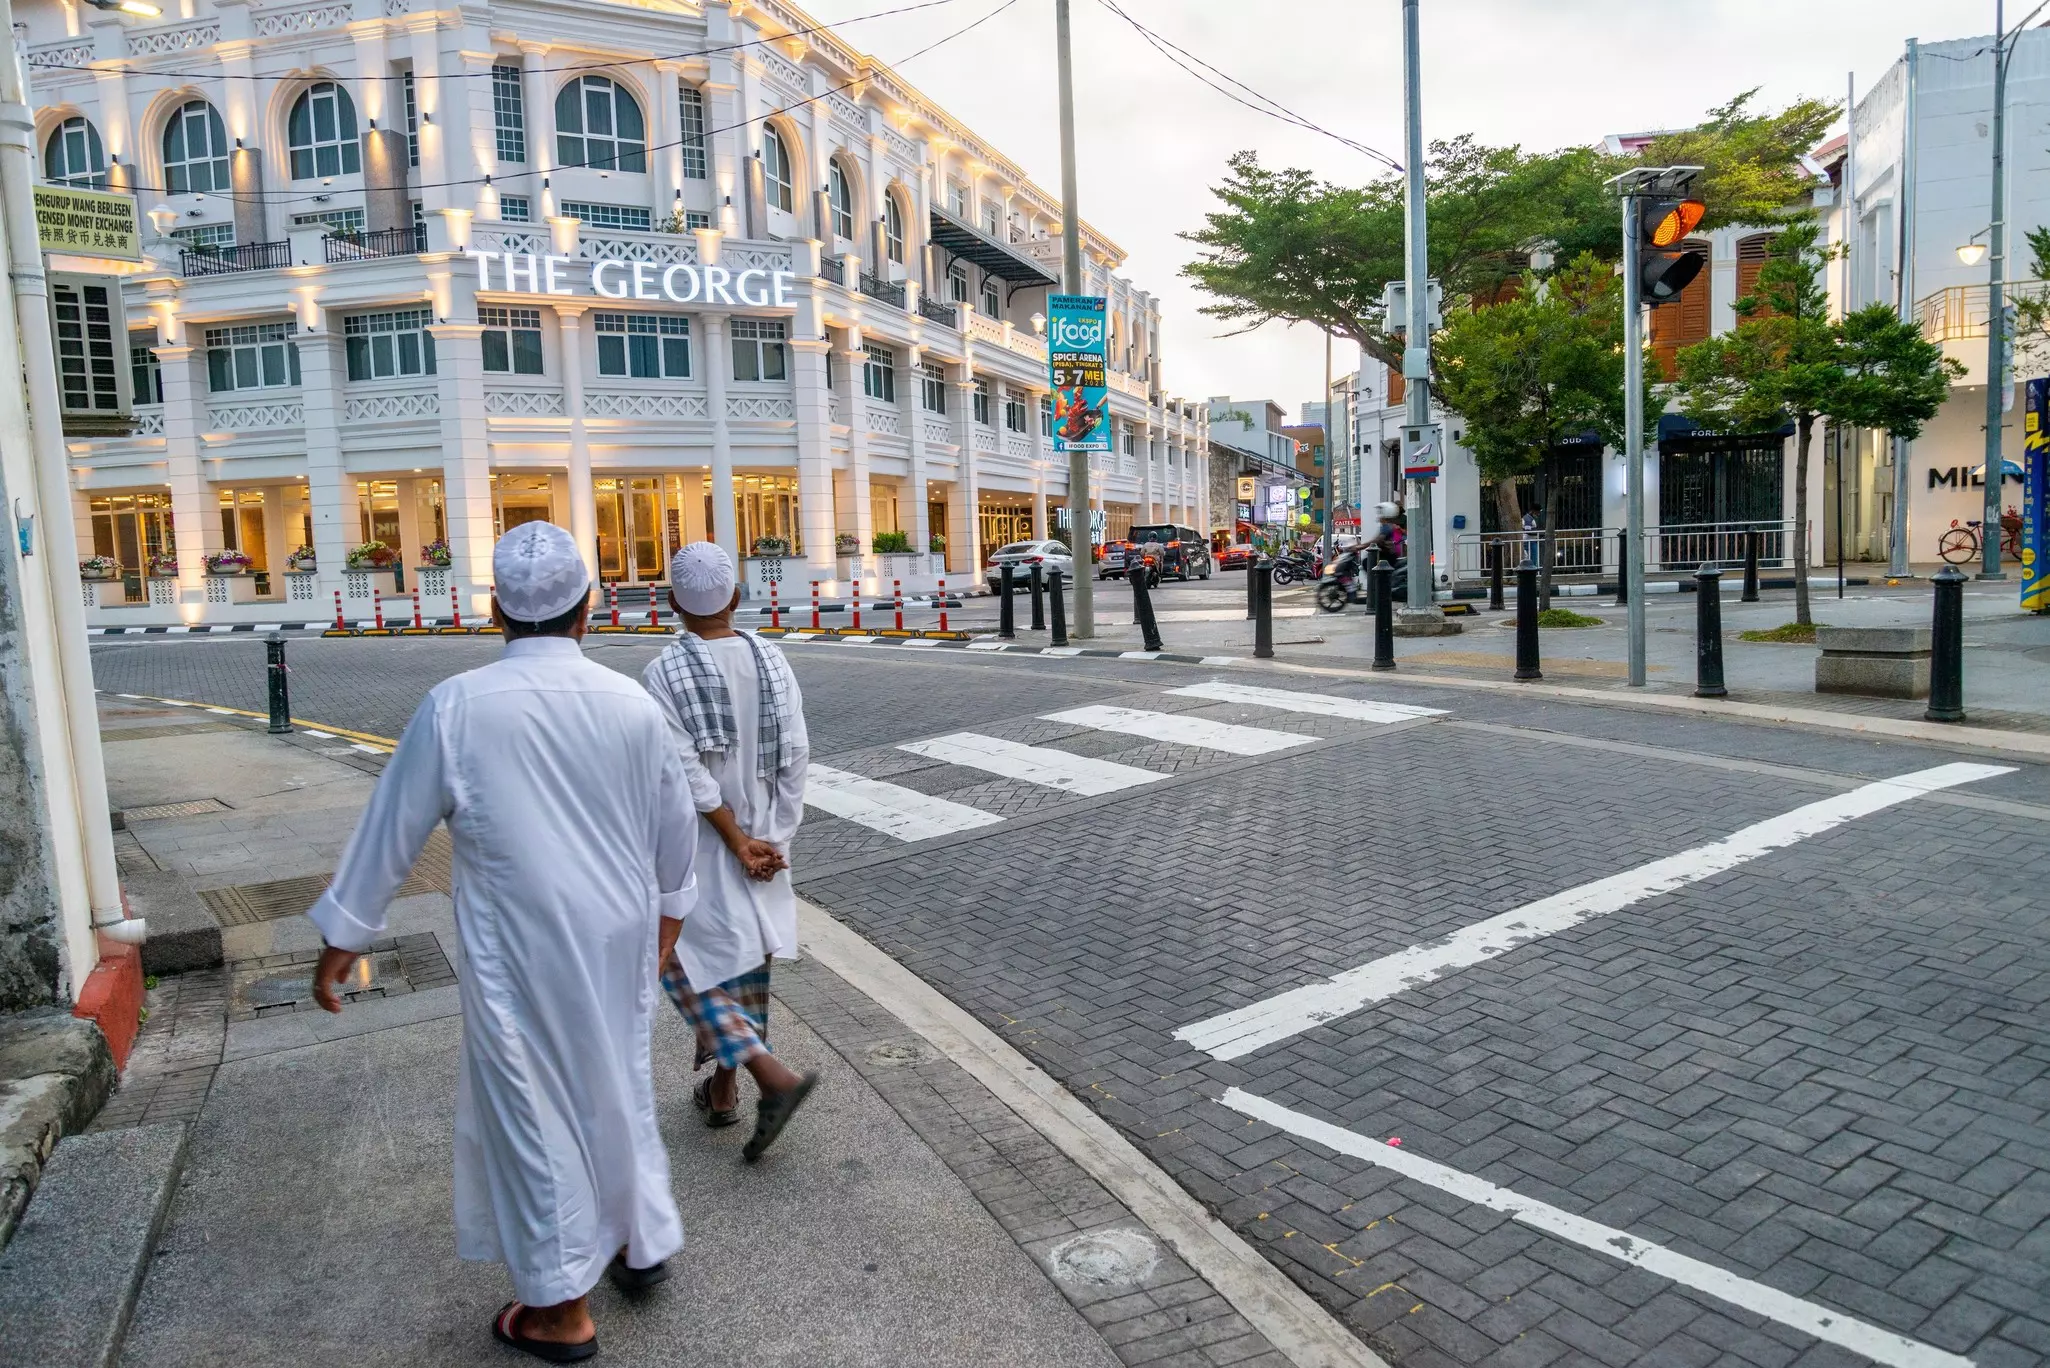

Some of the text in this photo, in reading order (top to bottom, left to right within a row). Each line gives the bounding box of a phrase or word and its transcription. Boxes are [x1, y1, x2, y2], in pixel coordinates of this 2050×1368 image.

[34, 193, 131, 218] ENGURUP WANG BERLESEN
[67, 213, 94, 230] MONEY
[95, 216, 133, 234] EXCHANGE
[40, 226, 128, 249] 持照货币兑换商
[465, 250, 798, 308] THE GEORGE
[1052, 296, 1092, 304] PAMERAN
[1052, 303, 1092, 311] MAKANAN
[1052, 352, 1103, 363] SPICE ARENA
[1053, 369, 1104, 386] 5 7 MEI
[1928, 466, 2024, 489] MILN
